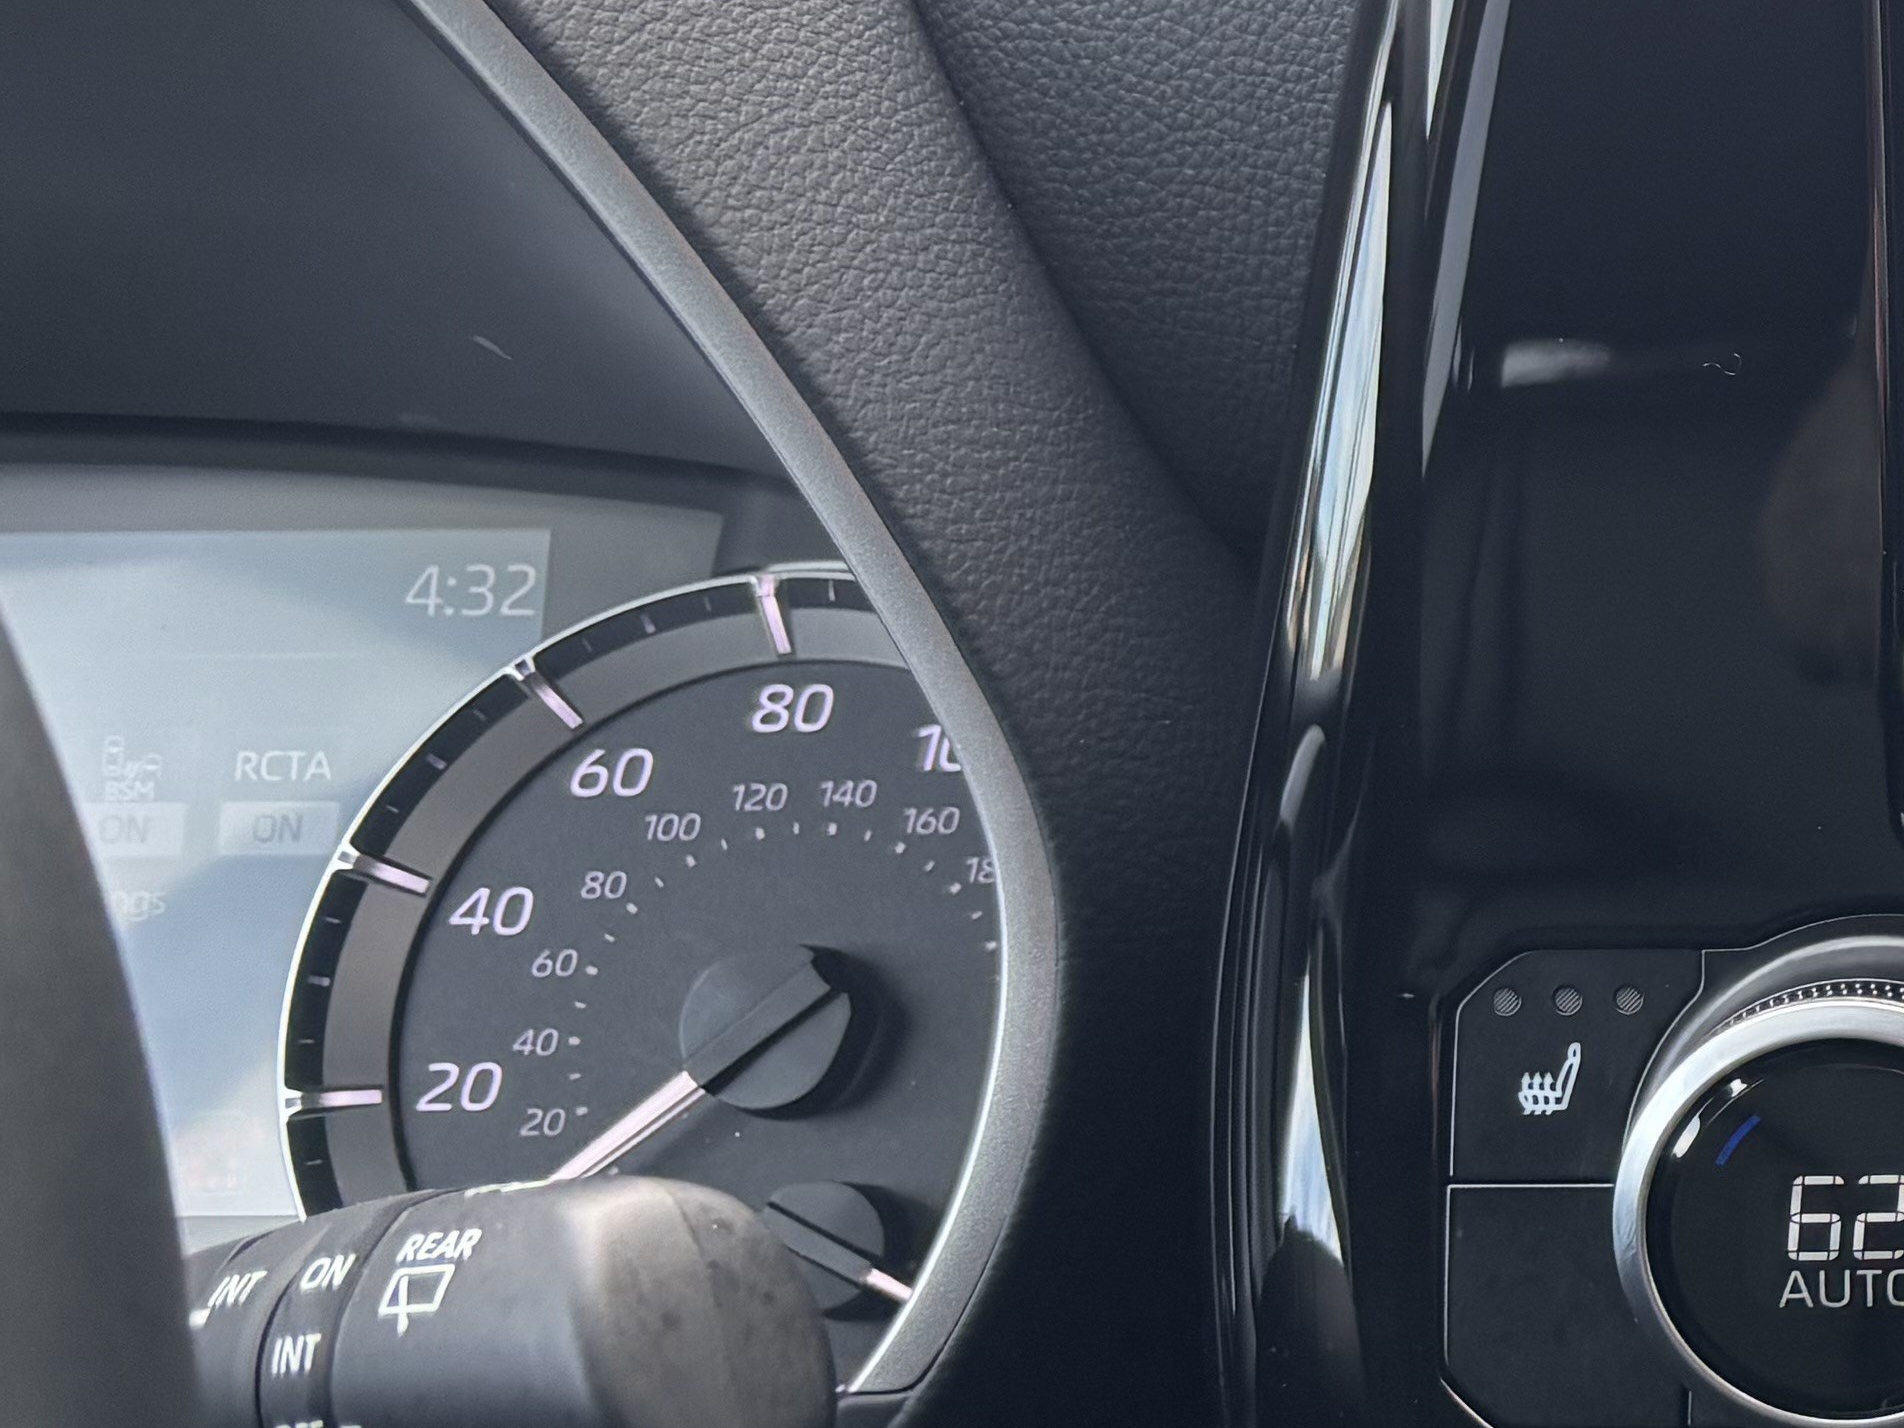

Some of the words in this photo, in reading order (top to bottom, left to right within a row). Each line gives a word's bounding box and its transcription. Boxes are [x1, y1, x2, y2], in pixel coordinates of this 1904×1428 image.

[405, 563, 538, 617] 4:32
[751, 685, 834, 734] 80
[235, 749, 332, 782] RCTA
[570, 747, 654, 798] 60
[731, 780, 788, 814] 120
[820, 778, 877, 810] 140
[253, 814, 302, 844] ON
[643, 811, 701, 843] 100
[903, 806, 960, 835] 160
[580, 869, 628, 901] 80
[448, 887, 534, 937] 40
[531, 949, 579, 979] 60
[512, 1027, 560, 1058] 40
[415, 1060, 502, 1113] 20
[519, 1106, 567, 1137] 20
[396, 1228, 483, 1265] REAR
[207, 1270, 268, 1308] INT
[301, 1253, 356, 1292] ON
[271, 1332, 322, 1376] INT
